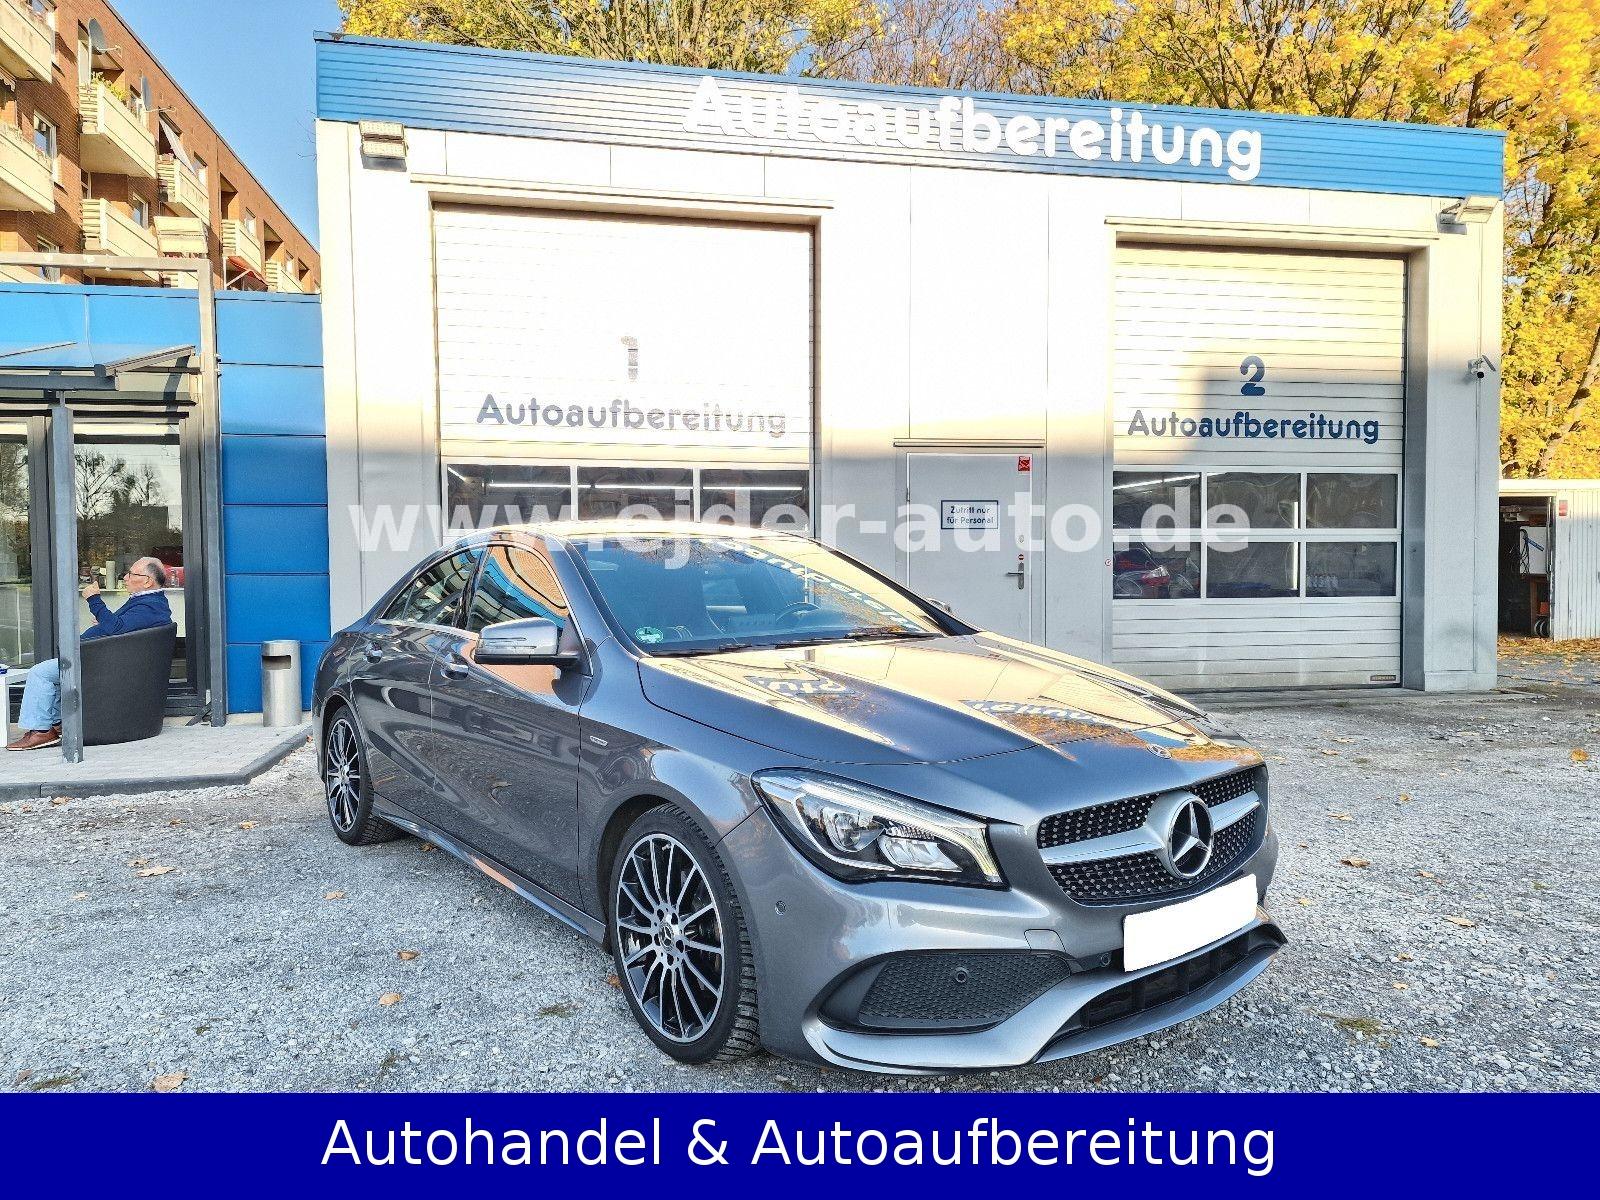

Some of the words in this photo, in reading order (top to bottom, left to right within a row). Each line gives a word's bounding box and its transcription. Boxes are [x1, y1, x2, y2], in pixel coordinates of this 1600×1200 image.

[683, 76, 1262, 182] Autoaufbereitung
[620, 335, 639, 382] 1
[1240, 355, 1266, 397] 2
[476, 393, 786, 438] Autoaufbereitung
[1127, 409, 1380, 445] Autoaufbereitung
[946, 516, 958, 524] für
[960, 516, 994, 524] Personal
[950, 506, 975, 514] Zutritt
